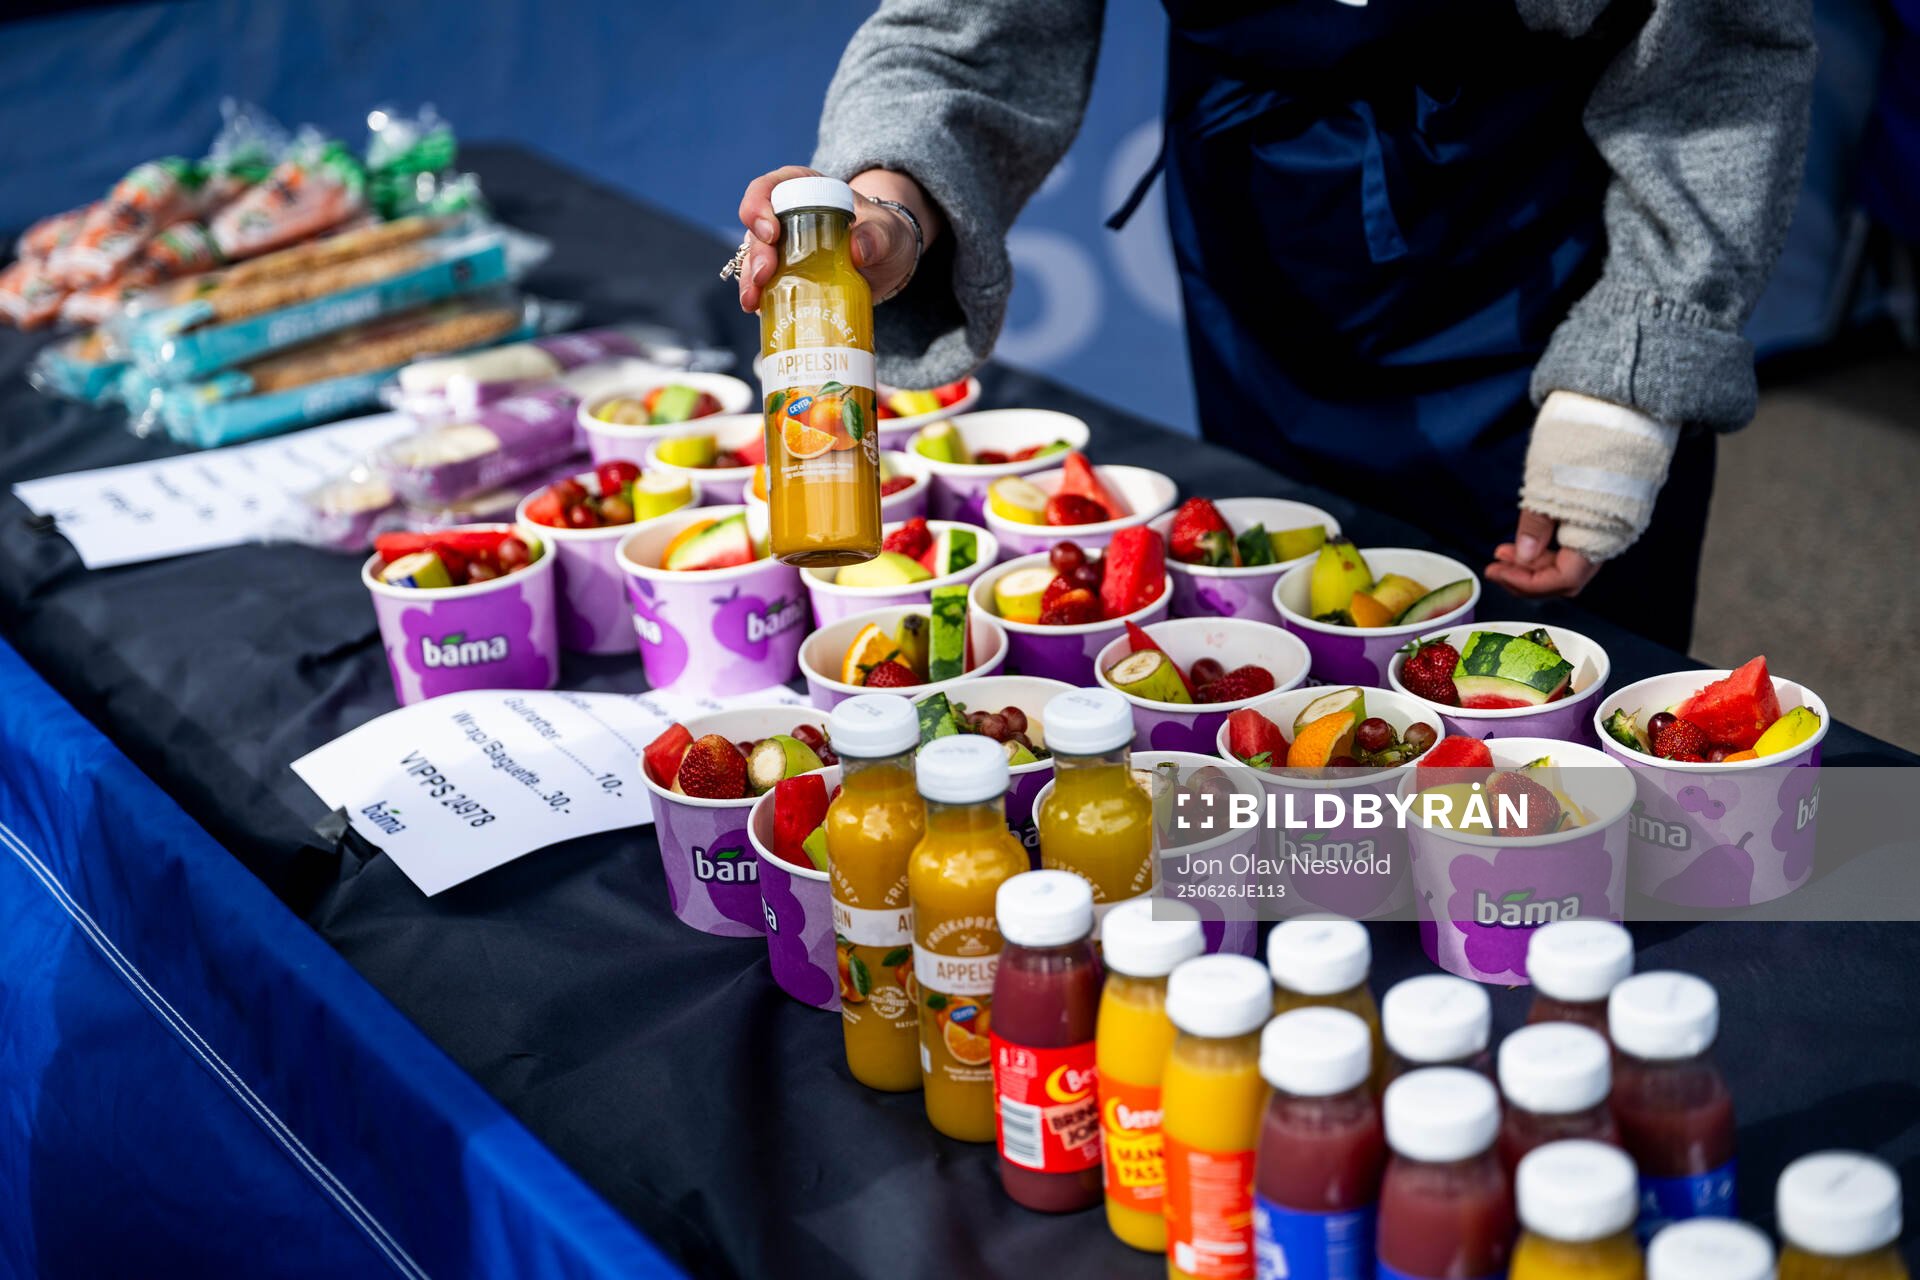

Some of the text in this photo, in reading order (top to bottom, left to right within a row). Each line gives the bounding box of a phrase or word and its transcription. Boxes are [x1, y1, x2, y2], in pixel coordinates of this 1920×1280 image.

[777, 351, 849, 377] APPELSIN
[421, 634, 508, 668] bama
[400, 749, 497, 829] VIPPS 24978
[360, 800, 408, 835] bama
[695, 850, 759, 882] bam
[1477, 892, 1581, 926] bama
[936, 961, 997, 982] APPELS
